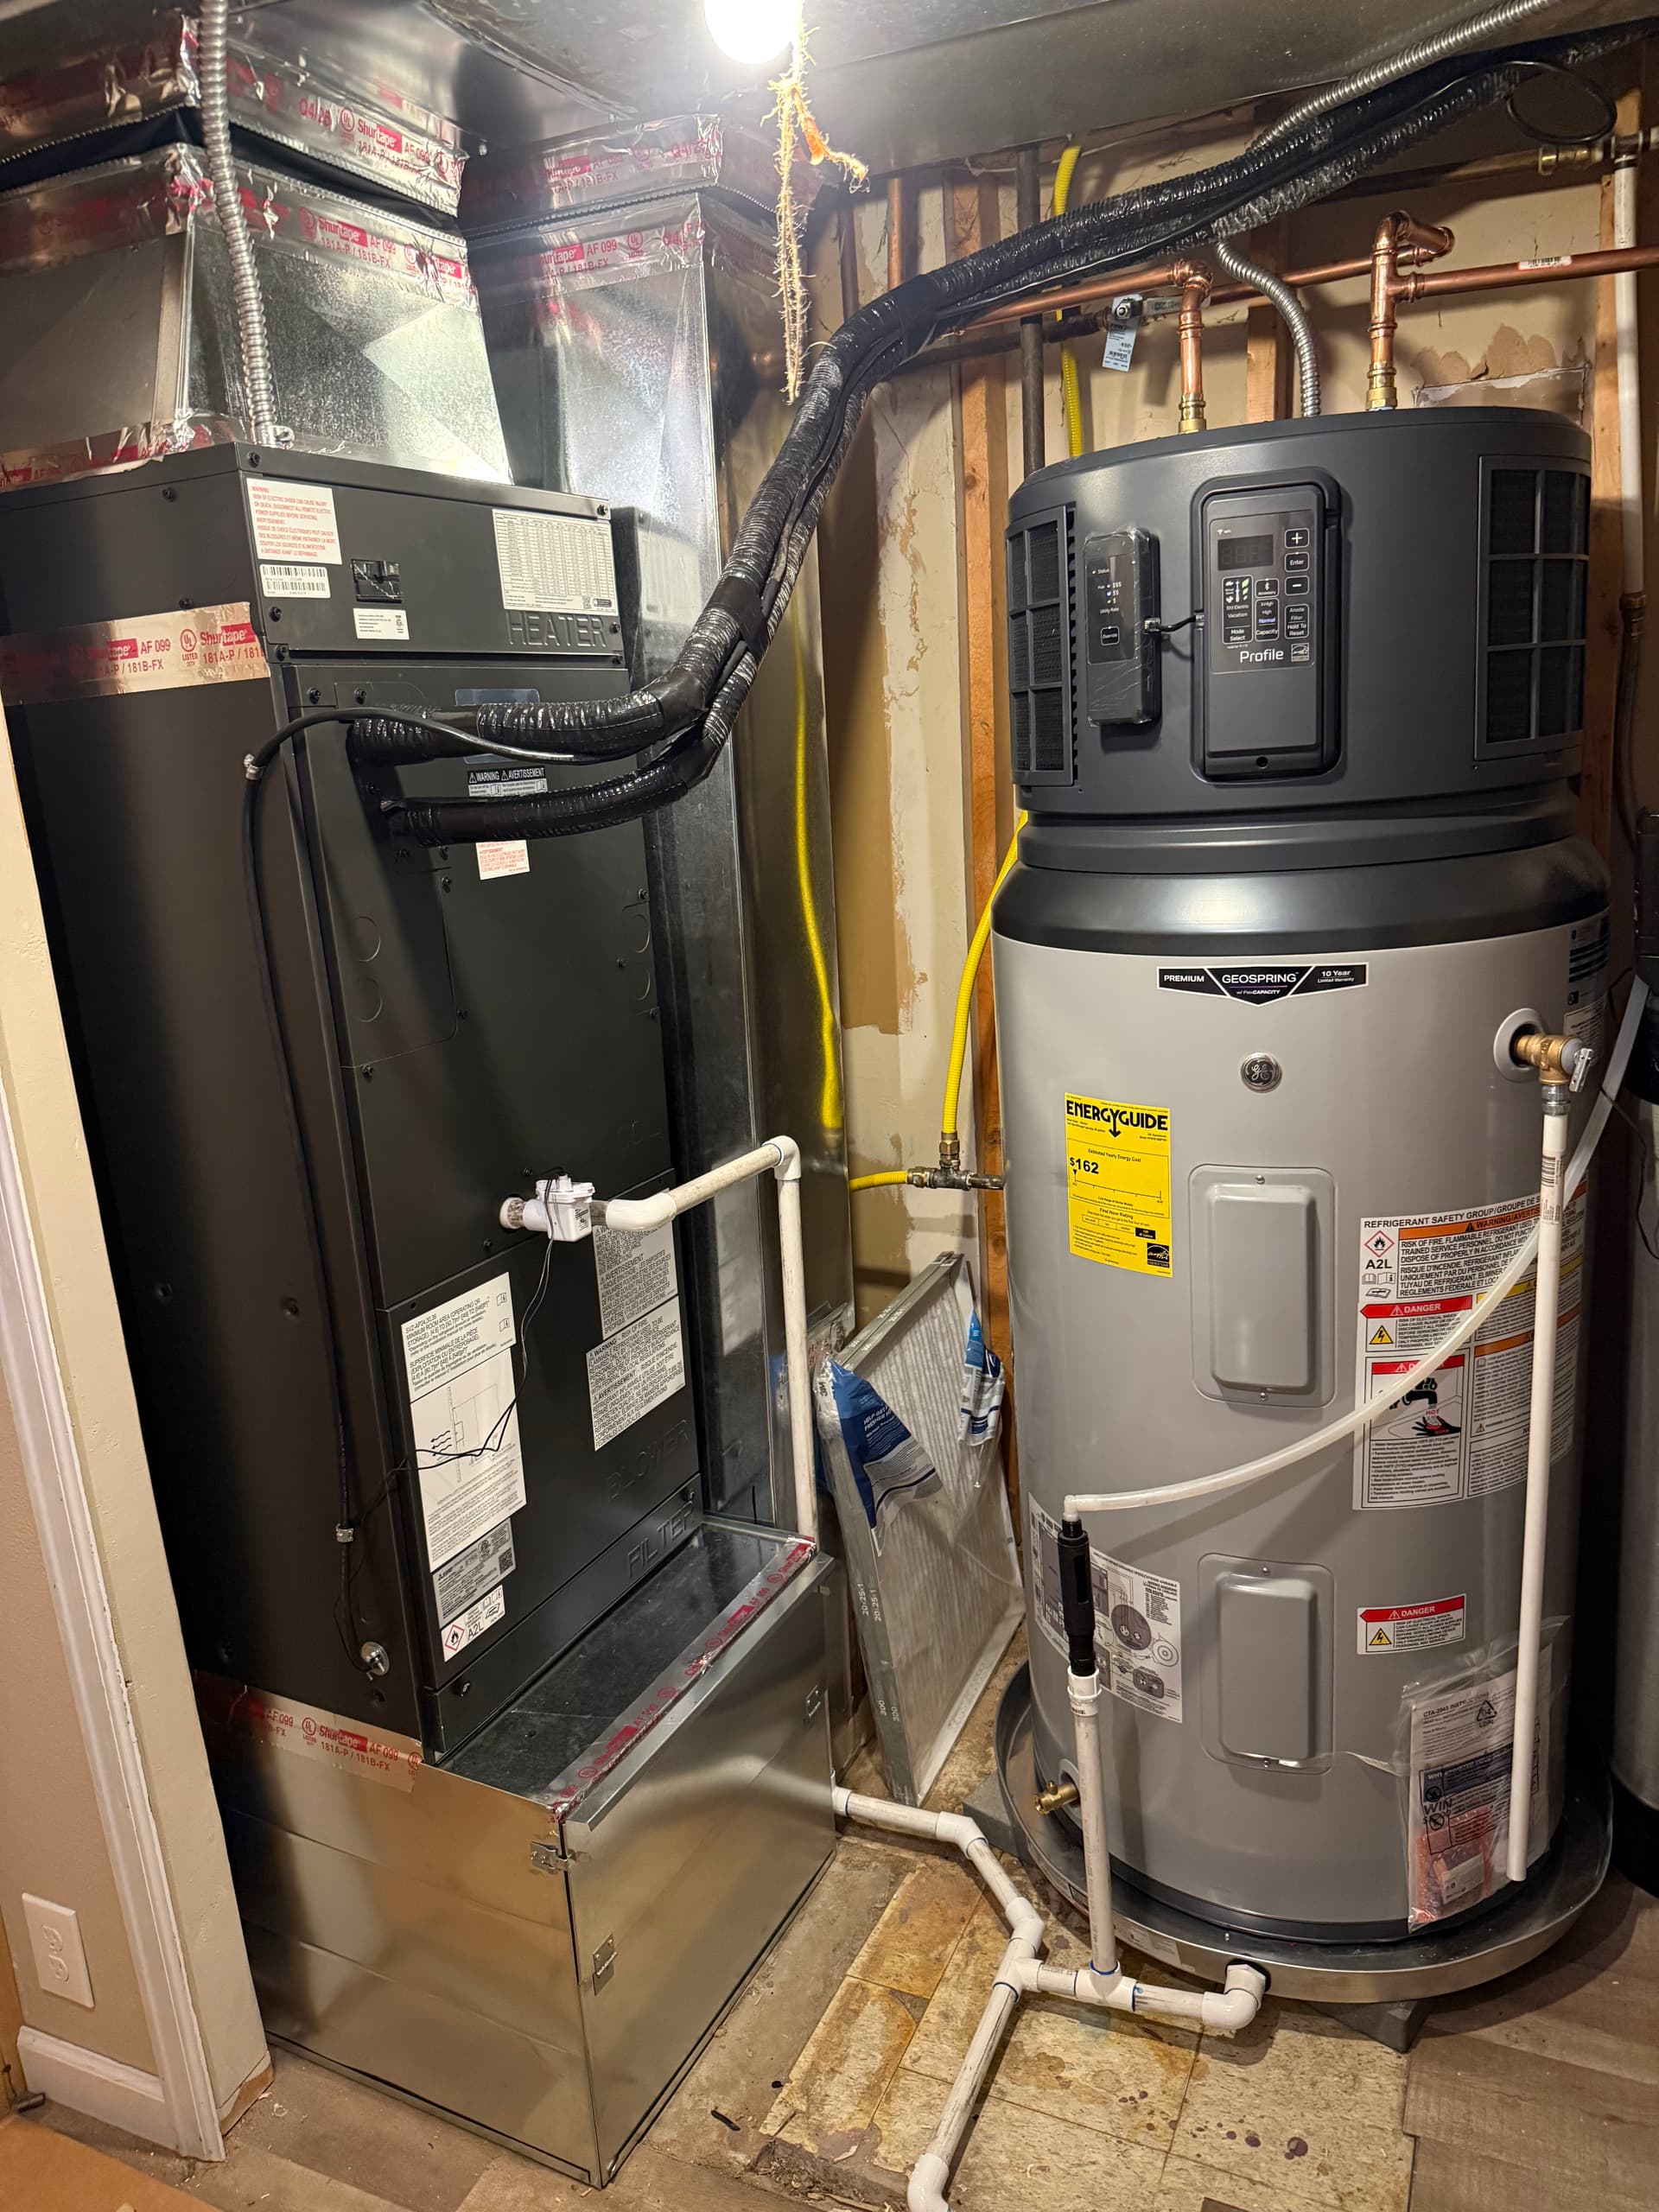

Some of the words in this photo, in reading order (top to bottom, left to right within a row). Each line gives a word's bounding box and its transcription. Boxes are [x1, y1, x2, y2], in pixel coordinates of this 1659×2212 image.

[358, 118, 397, 148] Shurtape
[587, 243, 599, 257] AF
[601, 239, 617, 252] 099
[505, 611, 607, 648] HEATER
[141, 641, 153, 654] AF
[155, 639, 171, 652] 099
[200, 628, 247, 646] Shurtape
[127, 658, 164, 673] 181B-FX
[203, 649, 235, 664] 181A-P
[1240, 648, 1284, 664] Profile
[476, 771, 499, 782] WARNING
[1222, 973, 1296, 985] GEOSPRING
[1066, 1100, 1168, 1131] ENERGYGUIDE
[1070, 1157, 1099, 1174] $162
[1364, 1217, 1430, 1228] REFRIGERANT
[1432, 1213, 1465, 1224] SAFETY
[1446, 1232, 1482, 1243] FLAMMABLE
[1483, 1224, 1518, 1238] REFRIGERANT
[1401, 1255, 1429, 1263] DISPOSE
[1441, 1249, 1473, 1259] PROPERLY
[1481, 1239, 1516, 1253] ACCORDANCE
[1402, 1247, 1429, 1255] TRAINED
[1431, 1243, 1458, 1253] SERVICE
[1503, 1232, 1514, 1241] NOT
[1365, 1259, 1393, 1269] A2L
[1464, 1254, 1502, 1267] REFRIGERANT
[1401, 1272, 1442, 1281] UNIQUEMENT
[1468, 1262, 1500, 1274] PERSONNEL
[1478, 1268, 1503, 1278] ELIMINER
[1400, 1287, 1444, 1296] REGLEMENTS
[1445, 1281, 1476, 1292] FEDERALE
[1404, 1303, 1441, 1313] DANGER
[594, 1338, 617, 1357] WARNING
[598, 1370, 637, 1399] AVERTISSEMENT
[626, 1503, 693, 1580] FILTER
[1401, 1606, 1435, 1618] DANGER
[467, 1622, 484, 1641] A2L
[279, 1713, 294, 1726] 099
[319, 1725, 359, 1748] Shurtape
[369, 1742, 381, 1755] AF
[383, 1745, 398, 1761] 099
[321, 1741, 348, 1758] 181A-P
[356, 1753, 389, 1770] 181B-FX
